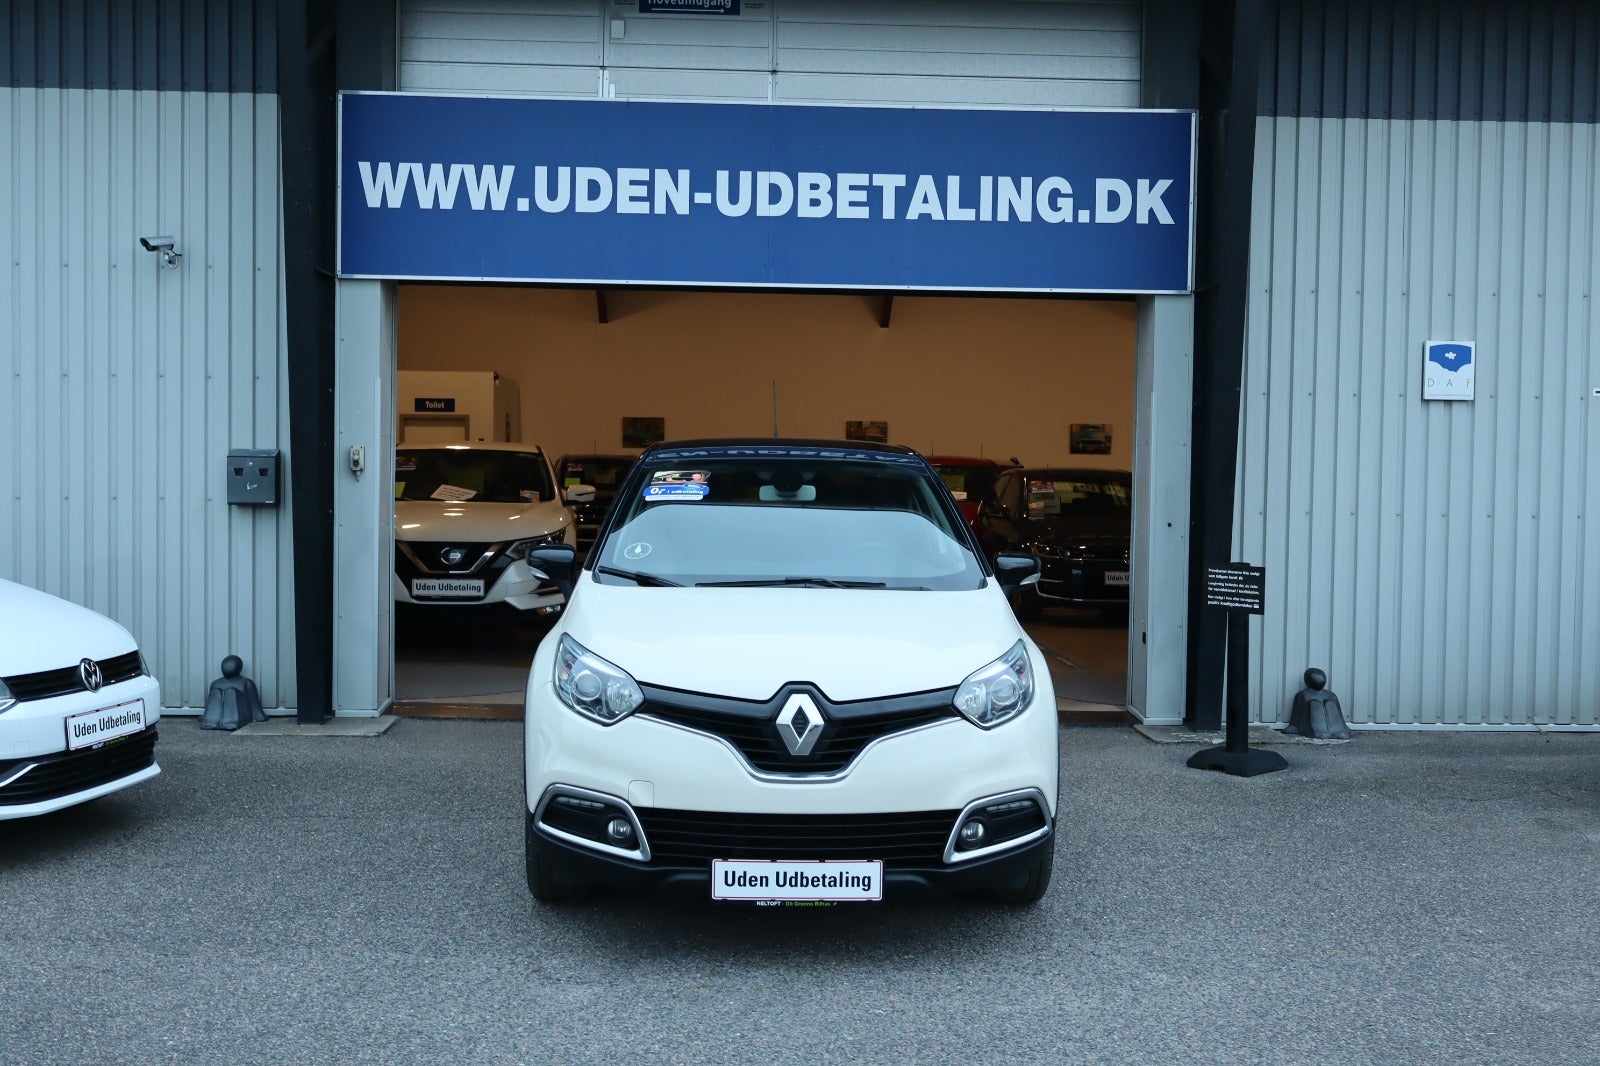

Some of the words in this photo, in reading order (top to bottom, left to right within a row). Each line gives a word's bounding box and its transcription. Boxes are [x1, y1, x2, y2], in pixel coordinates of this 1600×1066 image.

[357, 161, 1175, 225] WWW.UDEN-UDBETALING.DK
[425, 401, 445, 409] Toilet
[415, 583, 436, 591] Uden
[438, 583, 481, 593] Udbetaling
[73, 722, 97, 738] Uden
[98, 710, 141, 732] Udbetaling
[724, 870, 769, 887] Uden
[775, 871, 871, 891] Udbetaling
